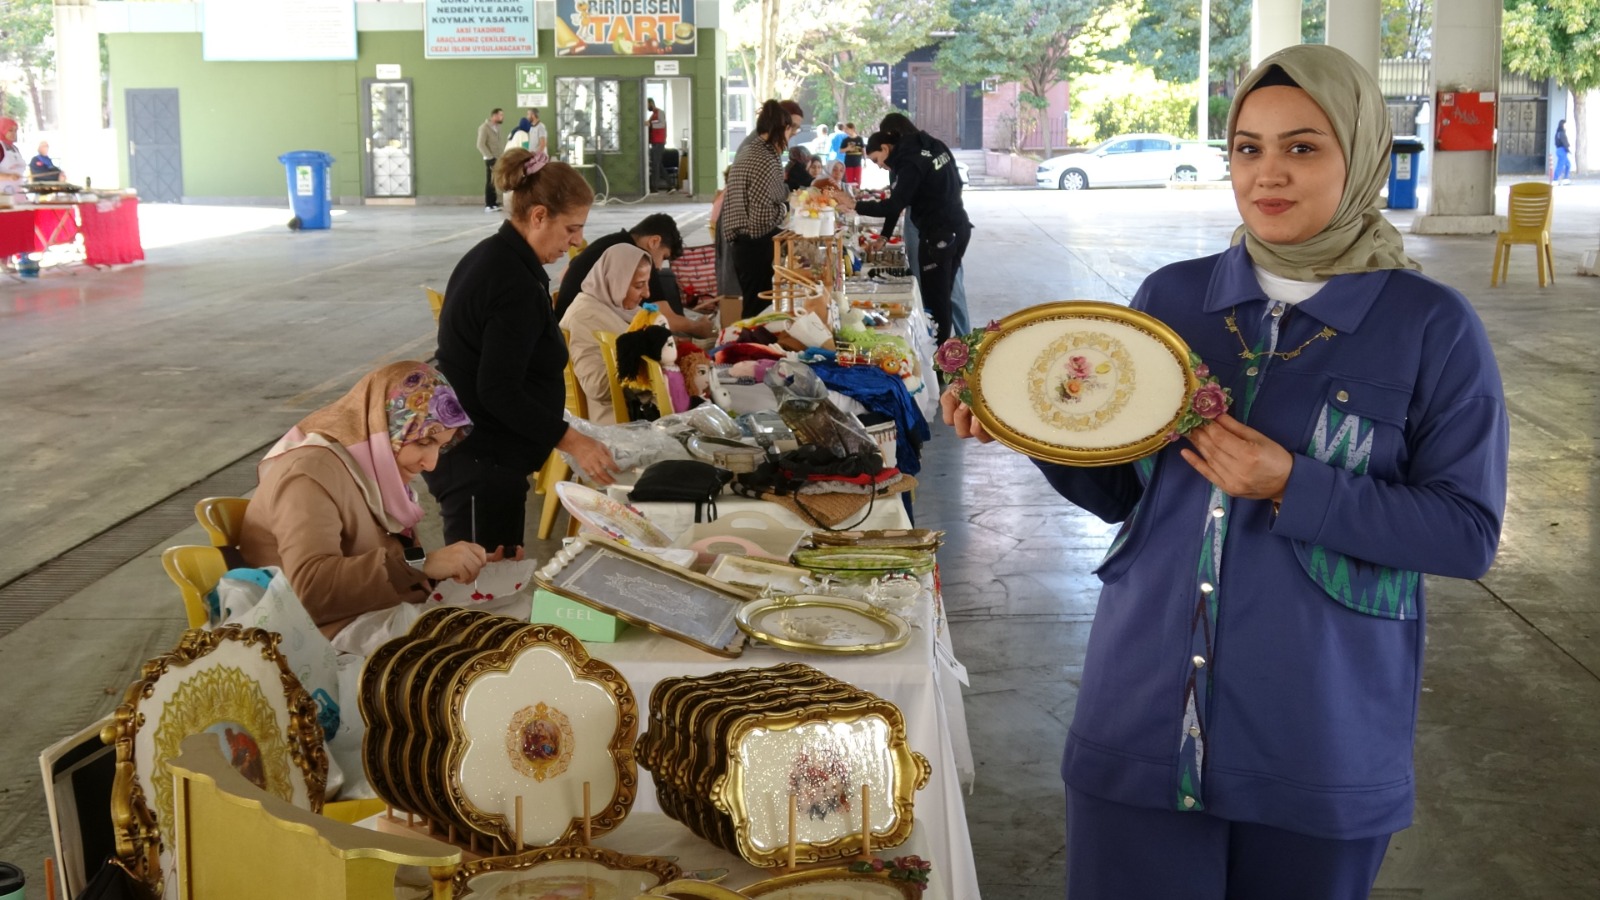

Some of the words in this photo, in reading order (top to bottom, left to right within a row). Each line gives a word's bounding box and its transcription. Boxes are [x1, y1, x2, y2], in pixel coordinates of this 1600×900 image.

[621, 0, 642, 14] DE
[647, 0, 680, 14] SEN
[589, 15, 680, 42] TART
